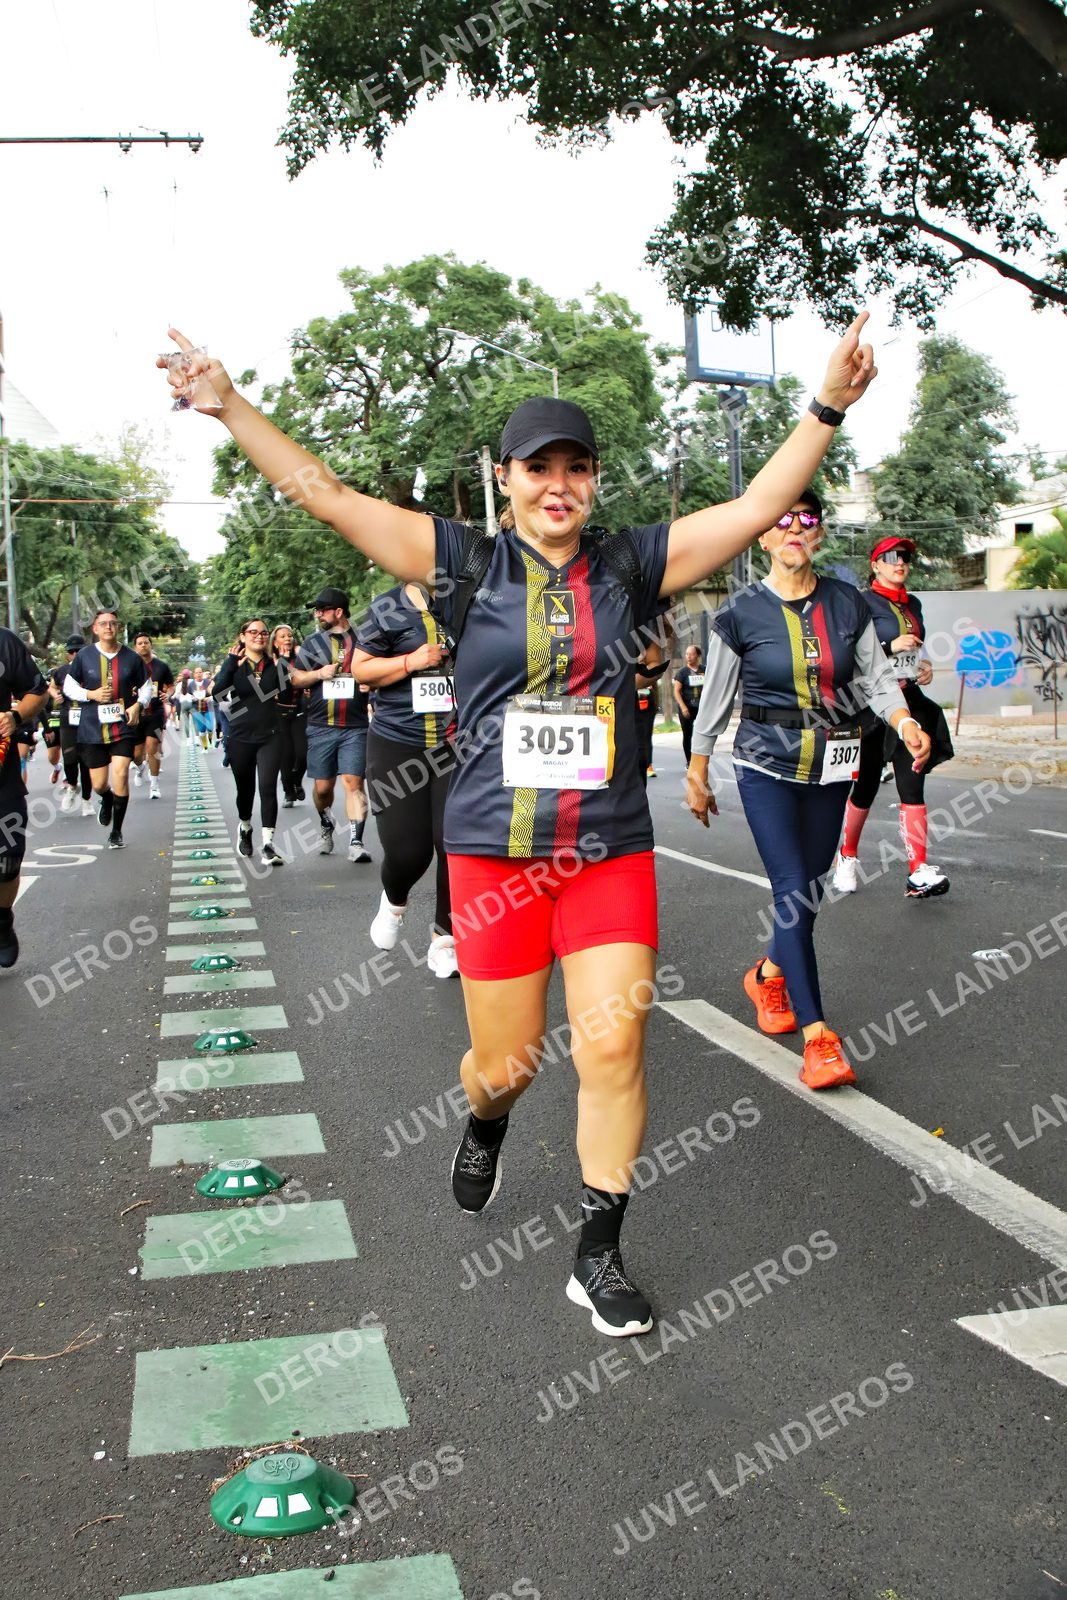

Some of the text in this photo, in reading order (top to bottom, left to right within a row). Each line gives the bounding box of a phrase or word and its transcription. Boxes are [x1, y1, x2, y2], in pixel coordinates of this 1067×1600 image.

[893, 655, 916, 667] 2158
[331, 680, 346, 689] 751
[102, 706, 120, 715] 4160
[518, 725, 590, 756] 3051
[830, 745, 860, 766] 3307
